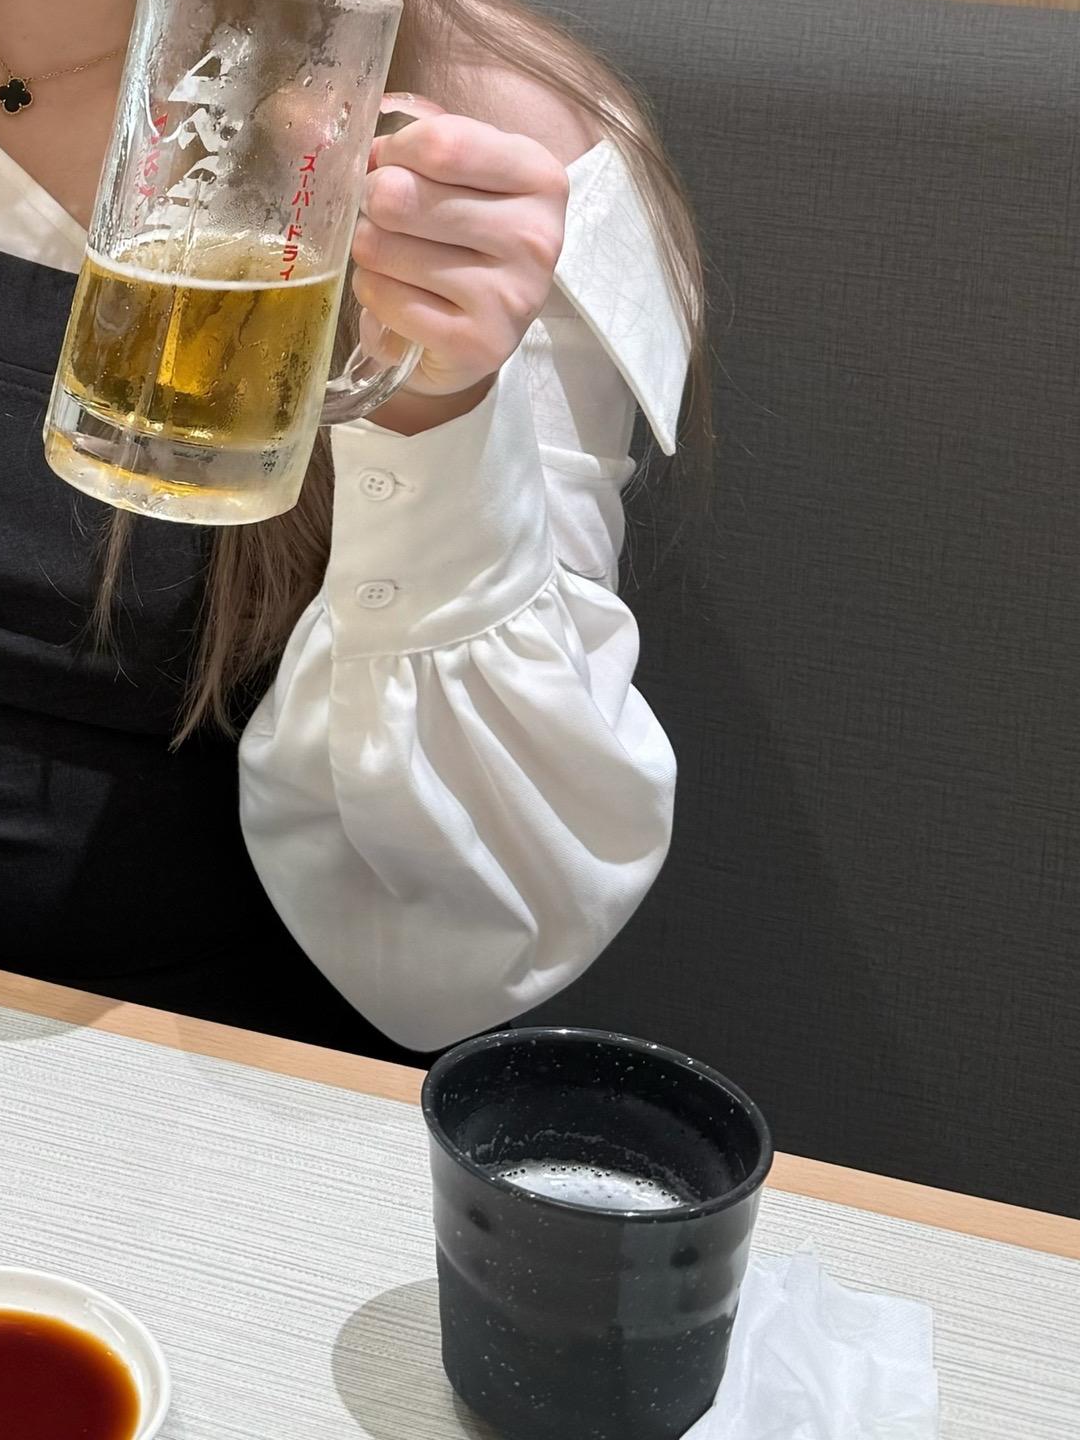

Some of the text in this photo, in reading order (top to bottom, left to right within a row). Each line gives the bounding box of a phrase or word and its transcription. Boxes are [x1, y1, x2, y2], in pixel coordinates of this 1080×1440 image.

[280, 155, 316, 281] スーパードライ
